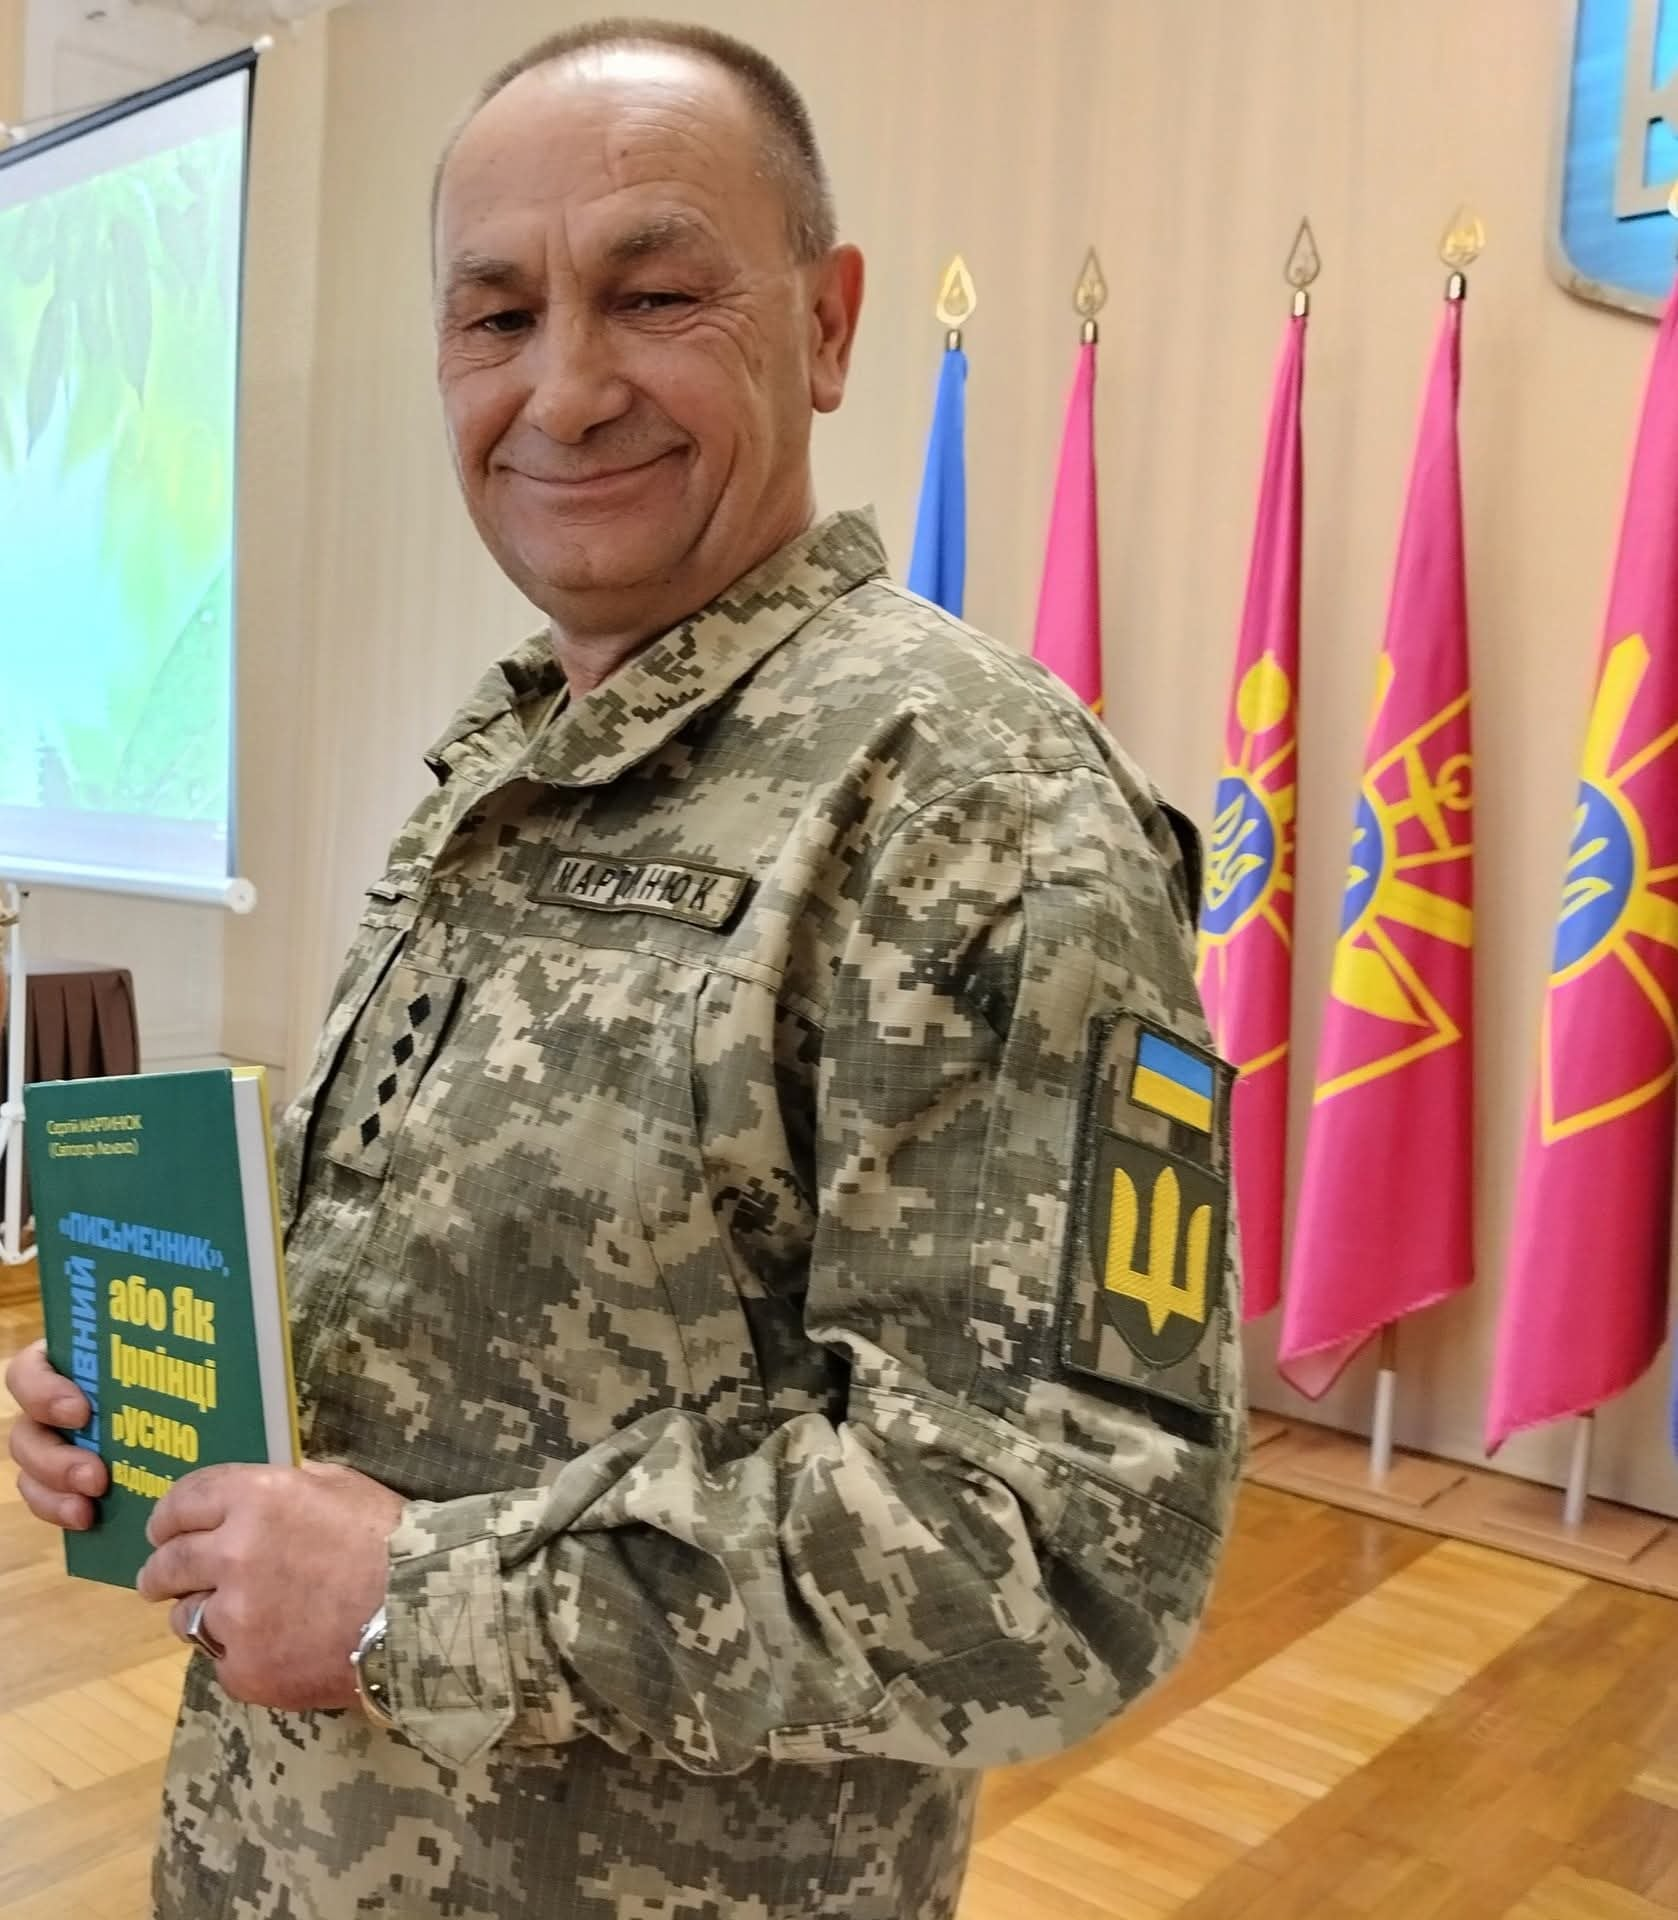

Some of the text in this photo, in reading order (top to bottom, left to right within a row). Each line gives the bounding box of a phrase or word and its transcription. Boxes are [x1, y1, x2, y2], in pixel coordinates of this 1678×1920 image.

[109, 1275, 216, 1345] або Як
[110, 1333, 217, 1413] Ірпінці
